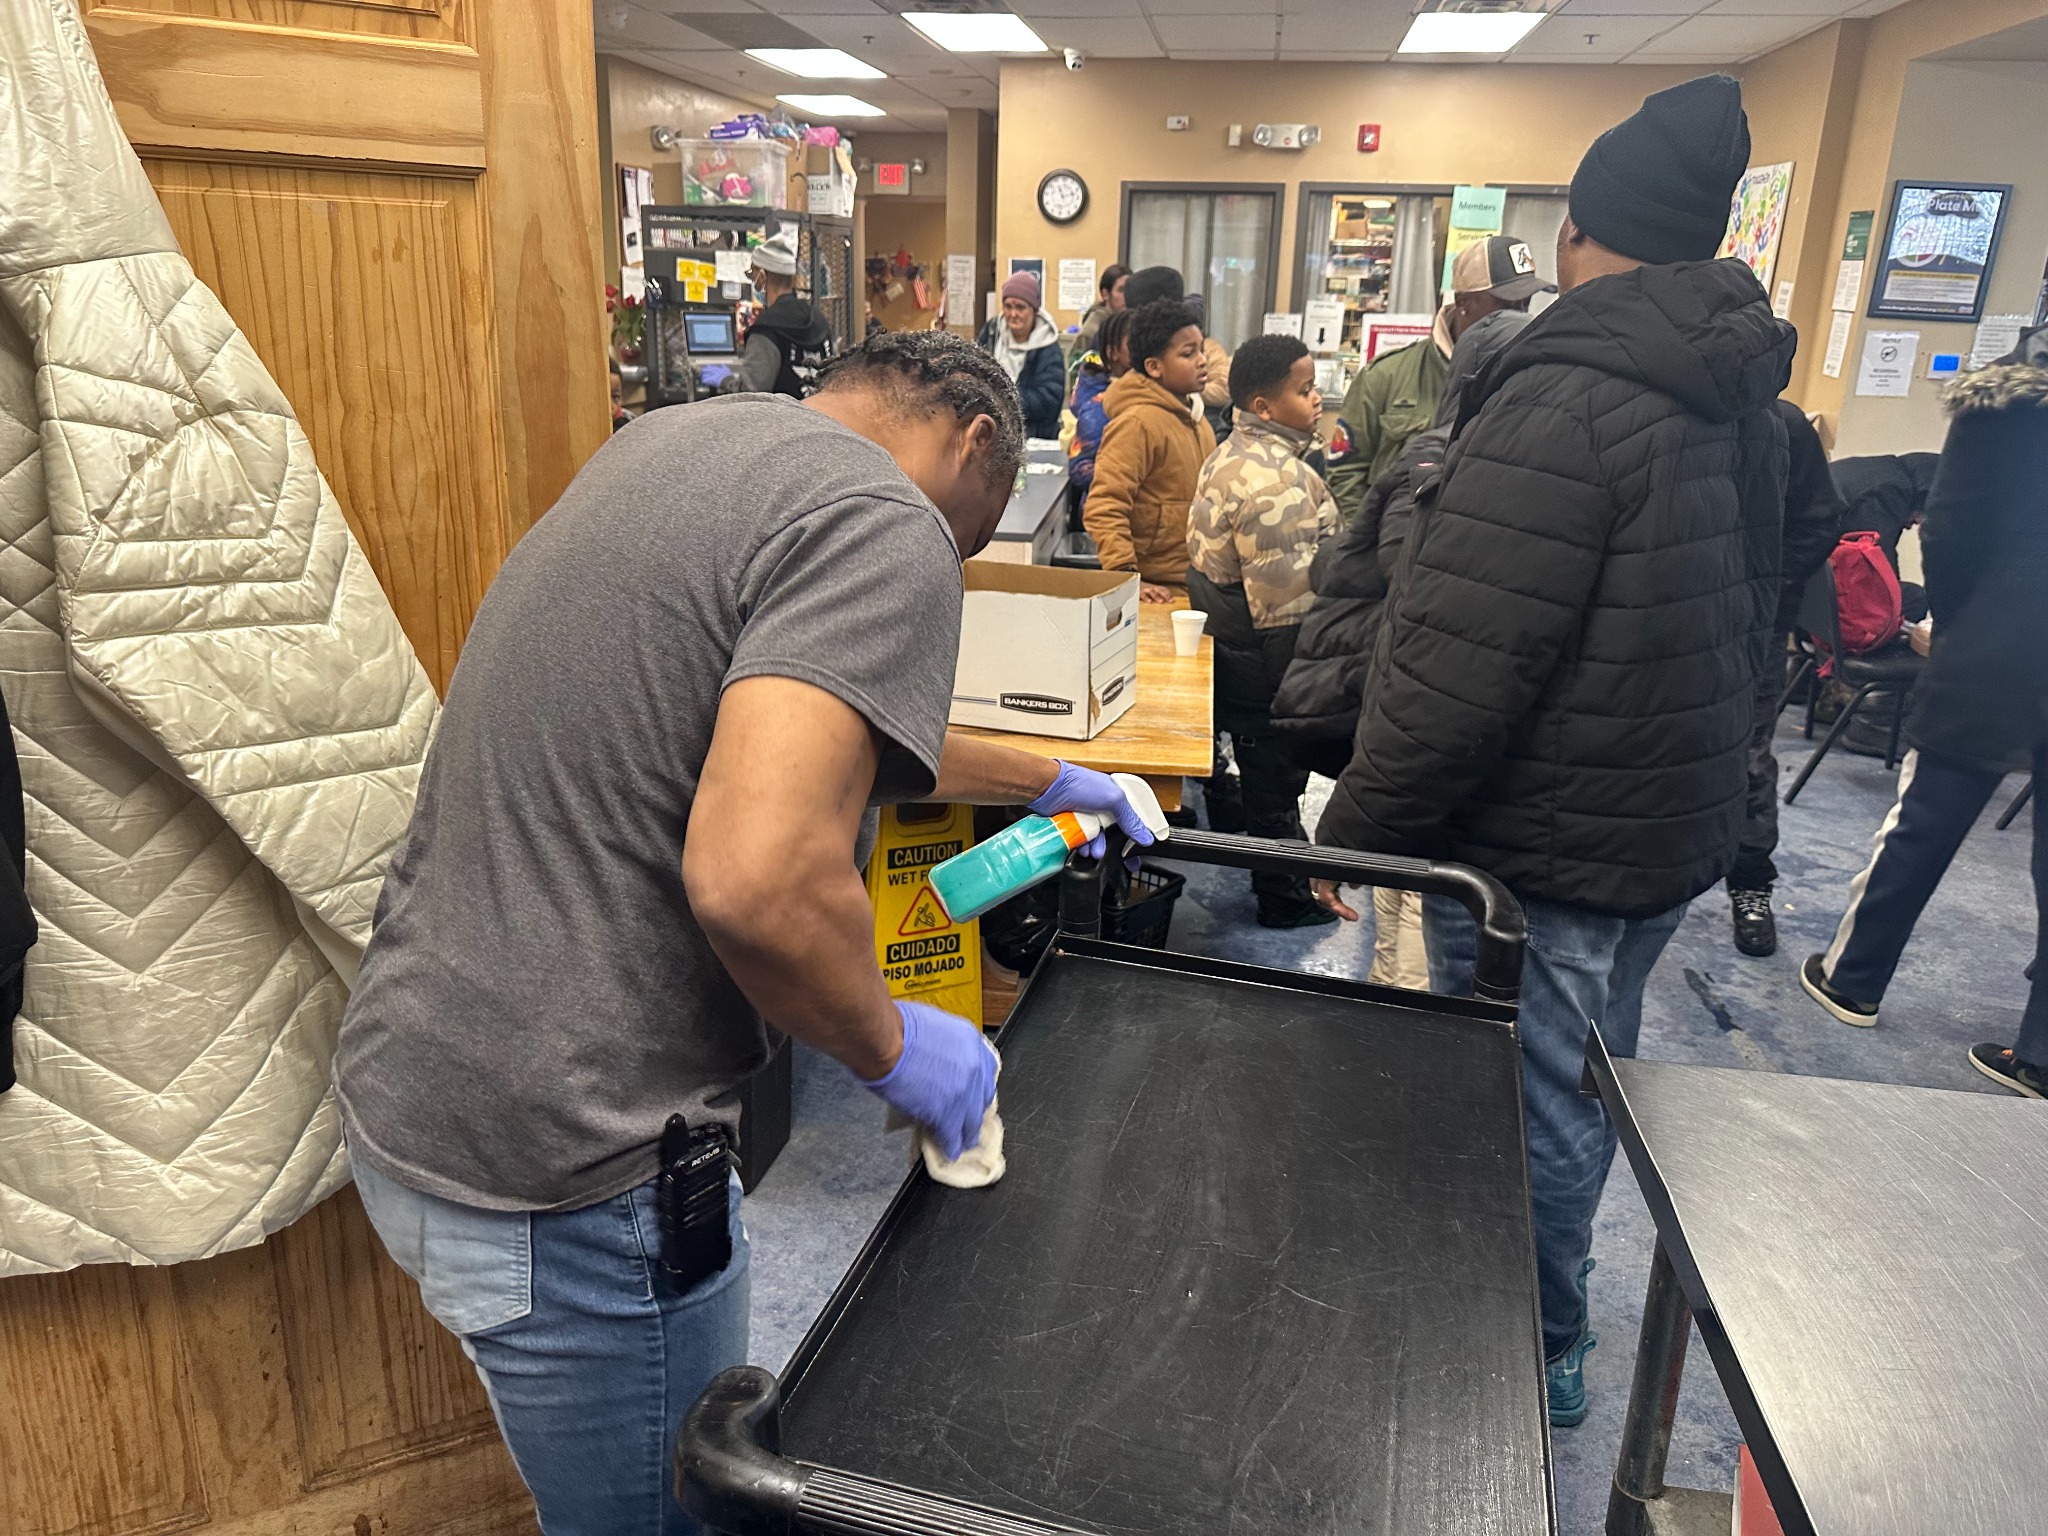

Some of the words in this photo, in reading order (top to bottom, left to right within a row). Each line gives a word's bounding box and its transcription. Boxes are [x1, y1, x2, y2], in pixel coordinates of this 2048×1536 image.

[879, 163, 905, 185] EXIT
[1458, 200, 1497, 212] Members
[1004, 697, 1048, 709] BANKERS
[1048, 702, 1069, 711] BOX
[894, 842, 958, 866] CAUTION
[888, 870, 917, 887] WET
[890, 937, 957, 962] CUIDADO
[882, 964, 911, 981] PISO
[914, 956, 965, 977] MOJADO
